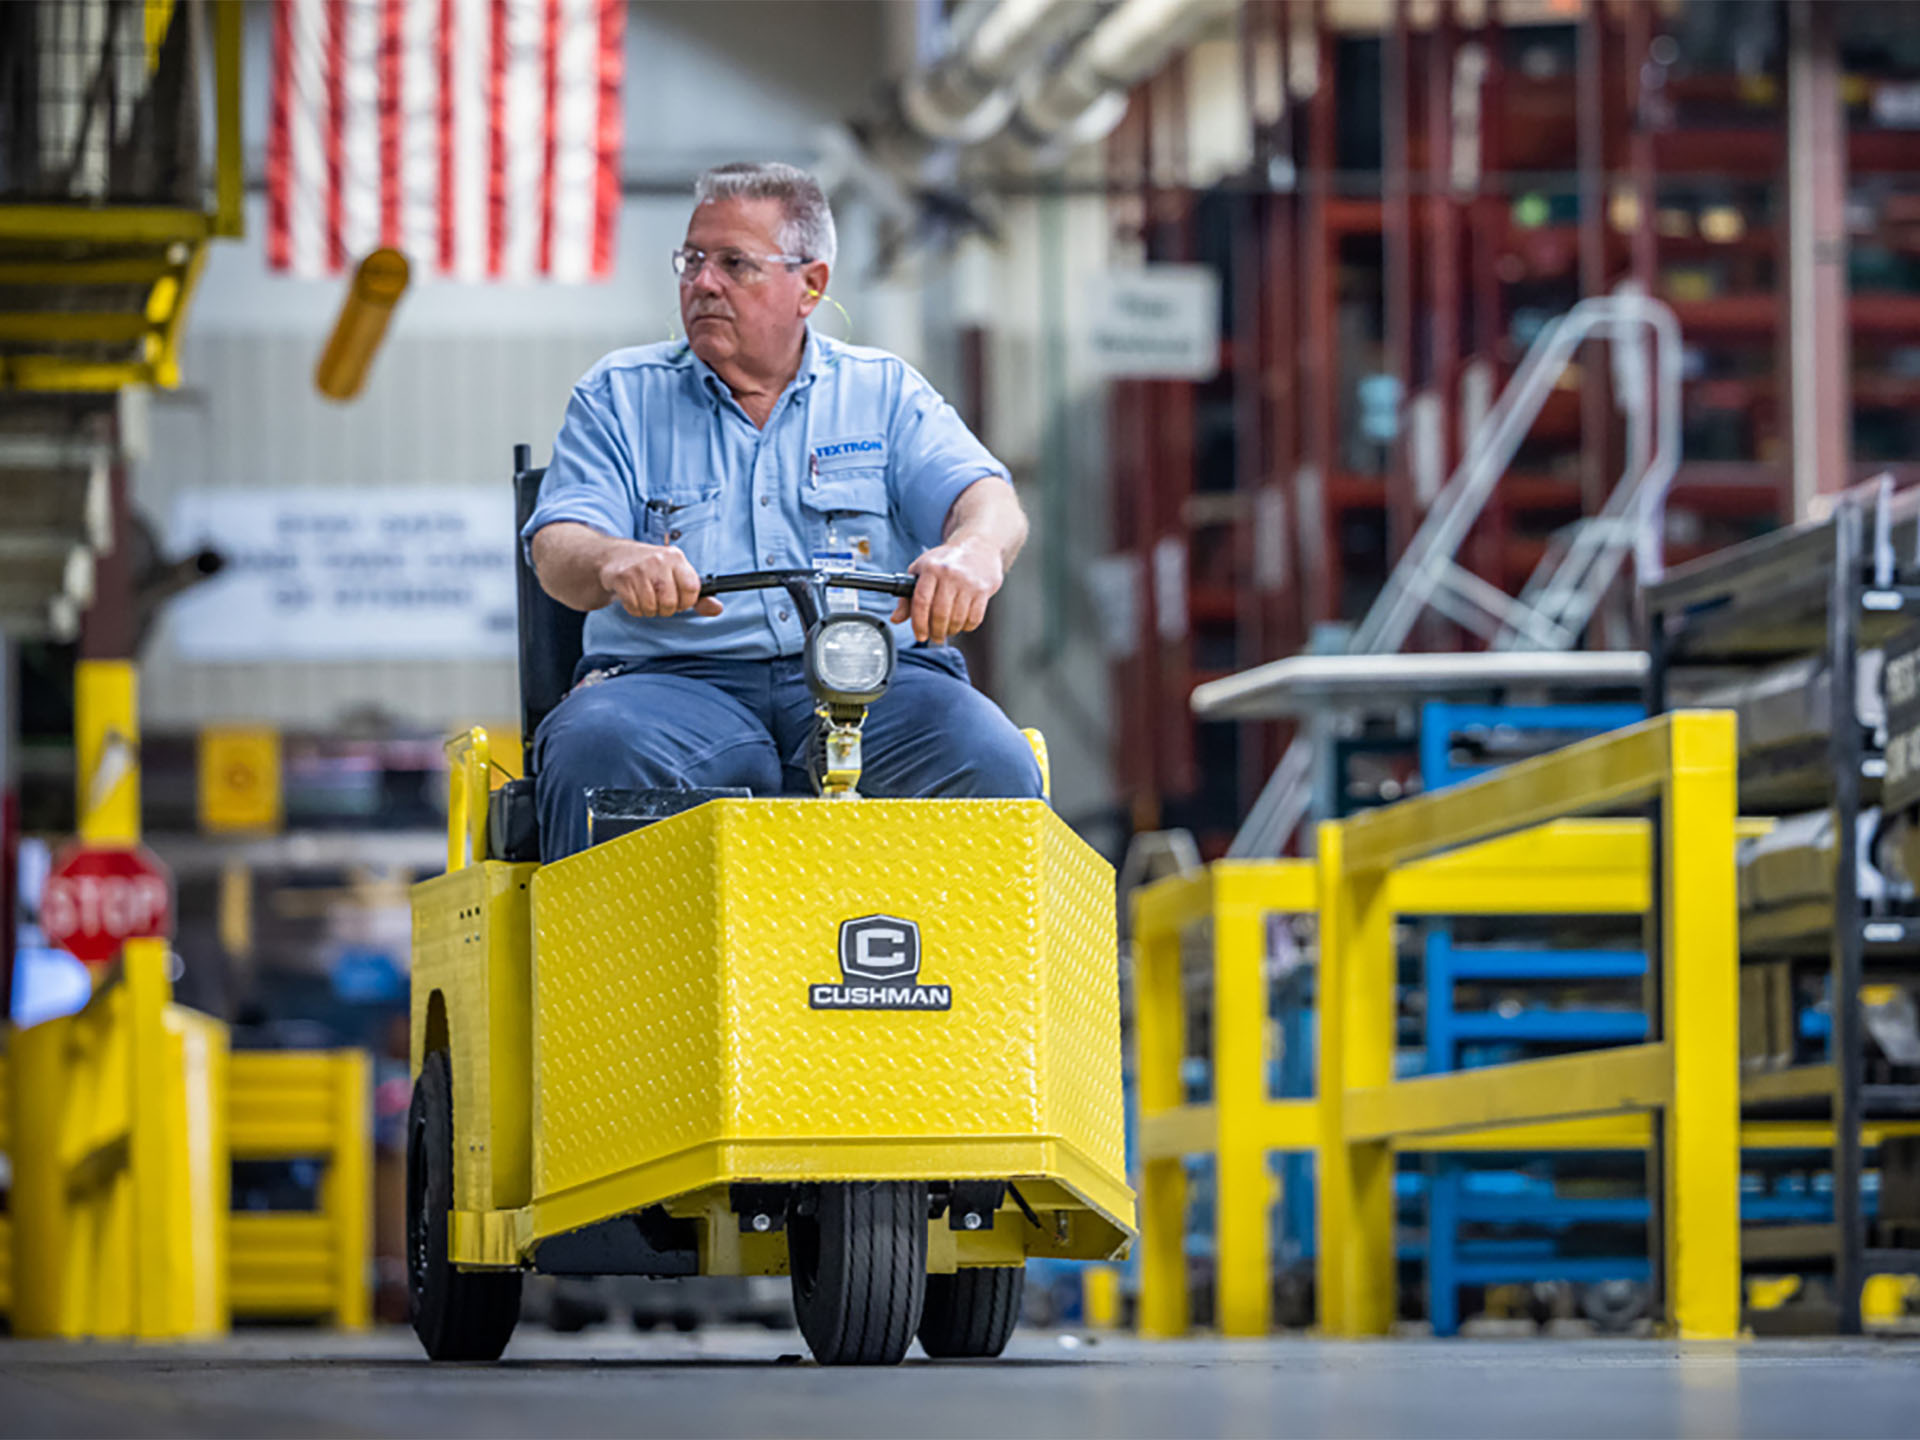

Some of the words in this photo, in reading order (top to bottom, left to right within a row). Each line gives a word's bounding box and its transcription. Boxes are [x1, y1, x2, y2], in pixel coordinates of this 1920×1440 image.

[816, 441, 882, 457] TEXTRON
[45, 875, 167, 938] STOP
[856, 928, 905, 967] C
[813, 986, 949, 1005] CUSHMAN
